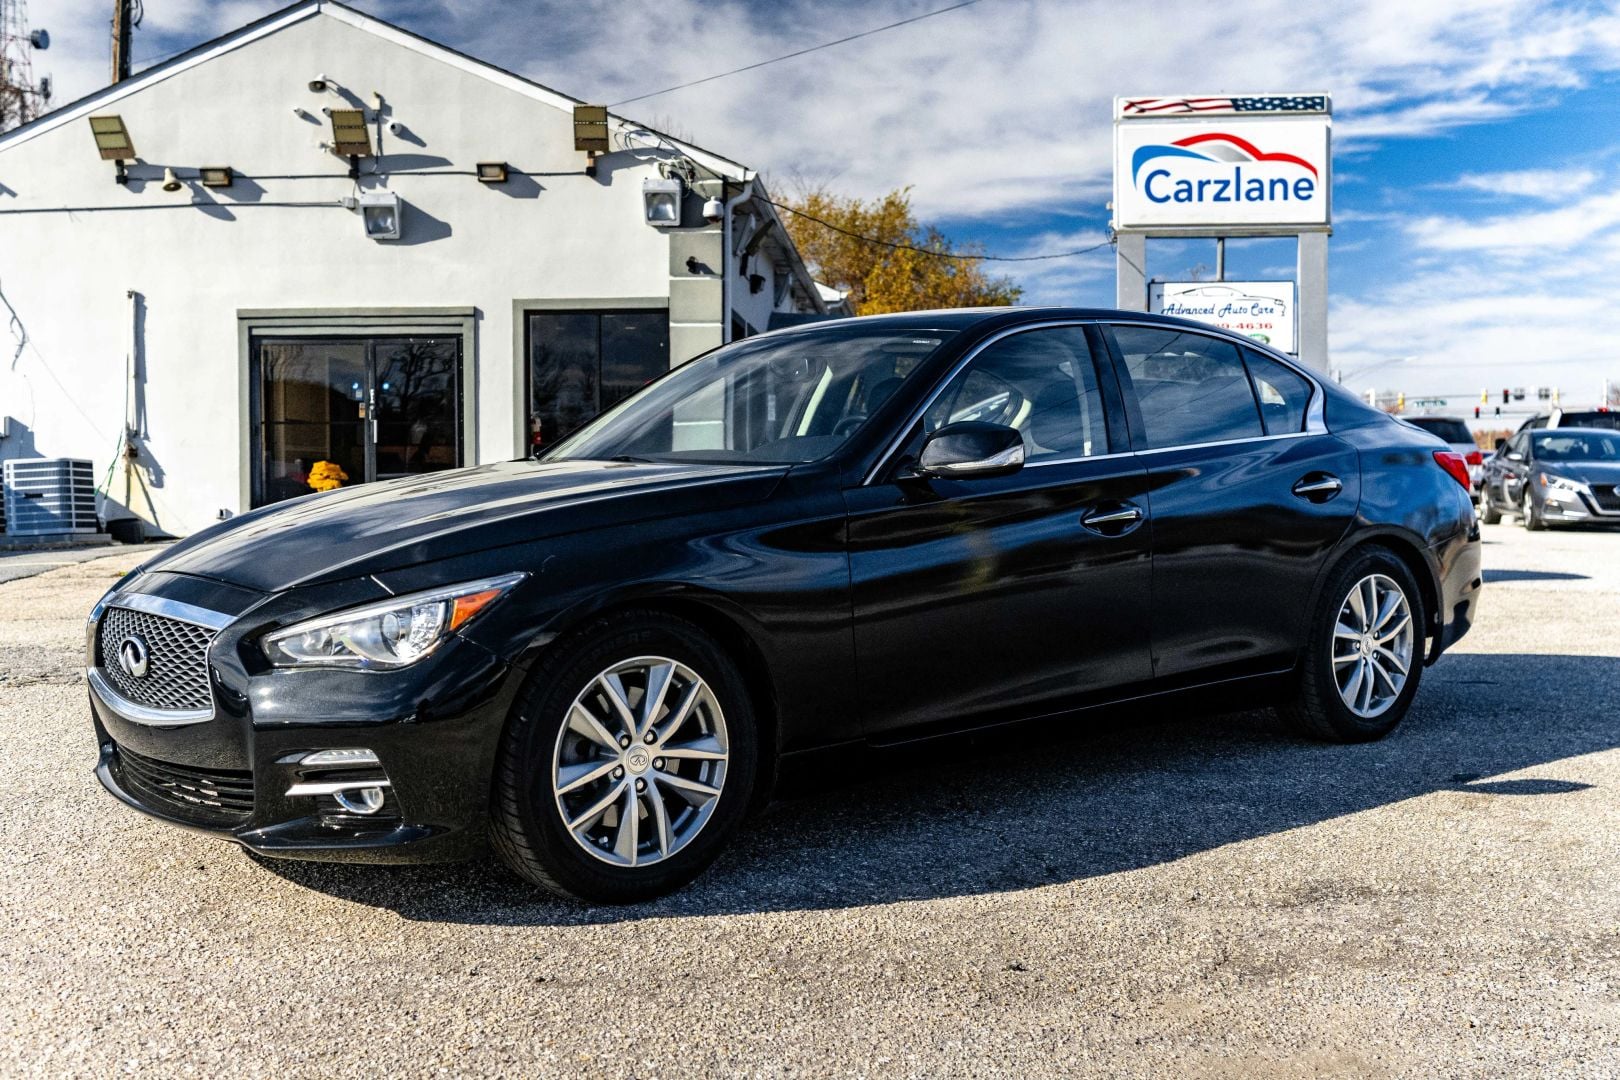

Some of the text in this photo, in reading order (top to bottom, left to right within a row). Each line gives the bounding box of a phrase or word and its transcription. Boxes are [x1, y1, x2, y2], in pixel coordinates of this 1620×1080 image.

[1144, 166, 1314, 204] Carzlane
[1161, 302, 1274, 318] Advanced Auto Care
